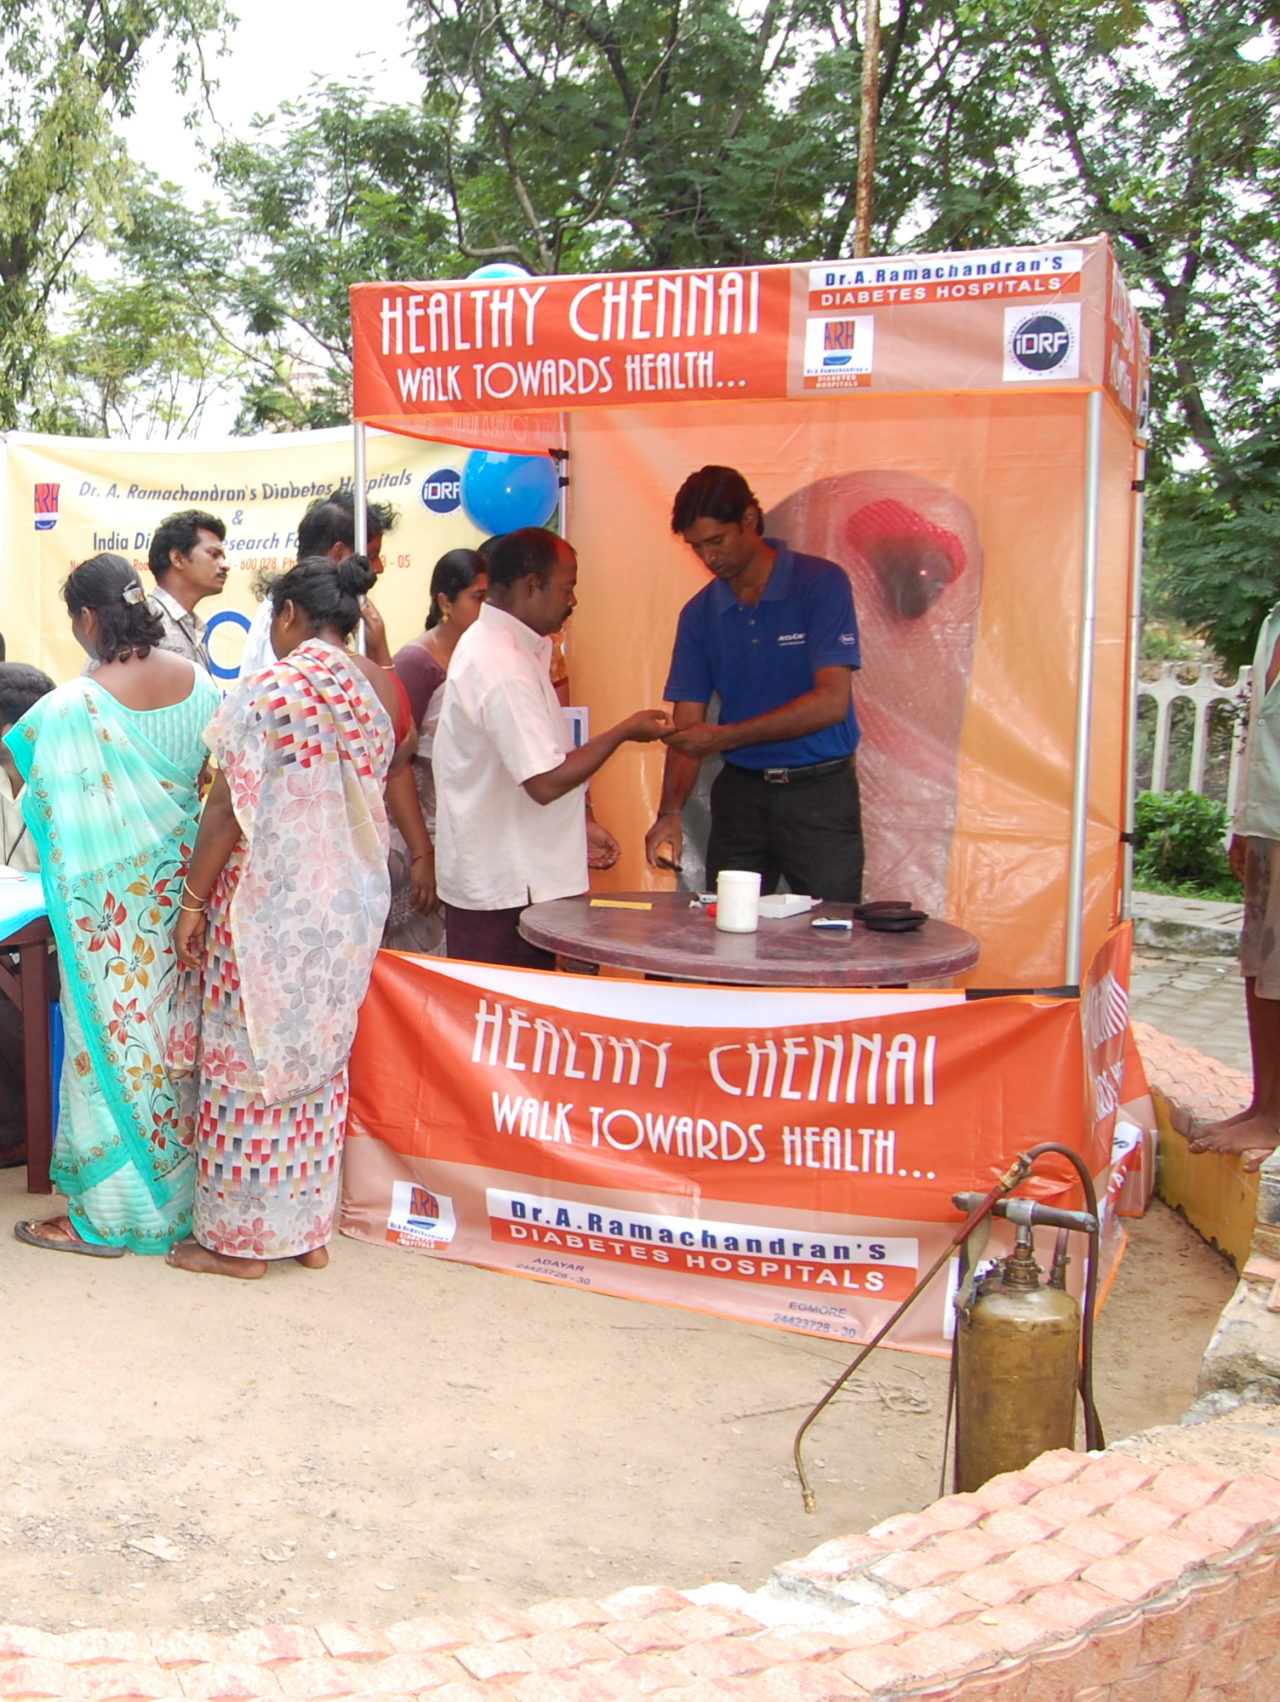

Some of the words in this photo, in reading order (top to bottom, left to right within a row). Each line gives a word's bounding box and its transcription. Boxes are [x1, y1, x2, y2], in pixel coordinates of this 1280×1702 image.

[821, 286, 926, 306] DIABETES
[936, 277, 1062, 299] HOSPITALS
[380, 286, 548, 355] HEALTHY
[568, 271, 760, 341] CHENNAI
[1016, 332, 1068, 355] iDRF
[397, 363, 462, 404] WALK
[473, 355, 612, 399] TOWARDS
[625, 350, 747, 392] HEALTH...
[79, 481, 100, 498] Dr.
[106, 483, 120, 499] A.
[126, 483, 257, 502] Ramachandran's
[262, 481, 334, 501] Diabetes
[340, 468, 413, 495] Hpitals
[231, 509, 245, 526] &
[93, 531, 129, 551] India
[222, 532, 280, 551] esearch
[133, 558, 150, 571] Roa
[240, 557, 257, 571] 600
[397, 554, 411, 569] 05
[471, 999, 673, 1089] HEALTHY
[708, 1033, 936, 1106] CHENNAI
[491, 1091, 573, 1144] WALK
[589, 1106, 766, 1163] TOWARDS
[782, 1126, 937, 1180] HEALTH...
[509, 1224, 670, 1264] DIABETES
[686, 1254, 885, 1292] HOSPITALS
[532, 1256, 586, 1273] ADAYAR
[577, 1275, 591, 1286] 30
[788, 1300, 848, 1319] EGMORE
[773, 1313, 831, 1333] 24423728
[841, 1326, 857, 1339] 30
